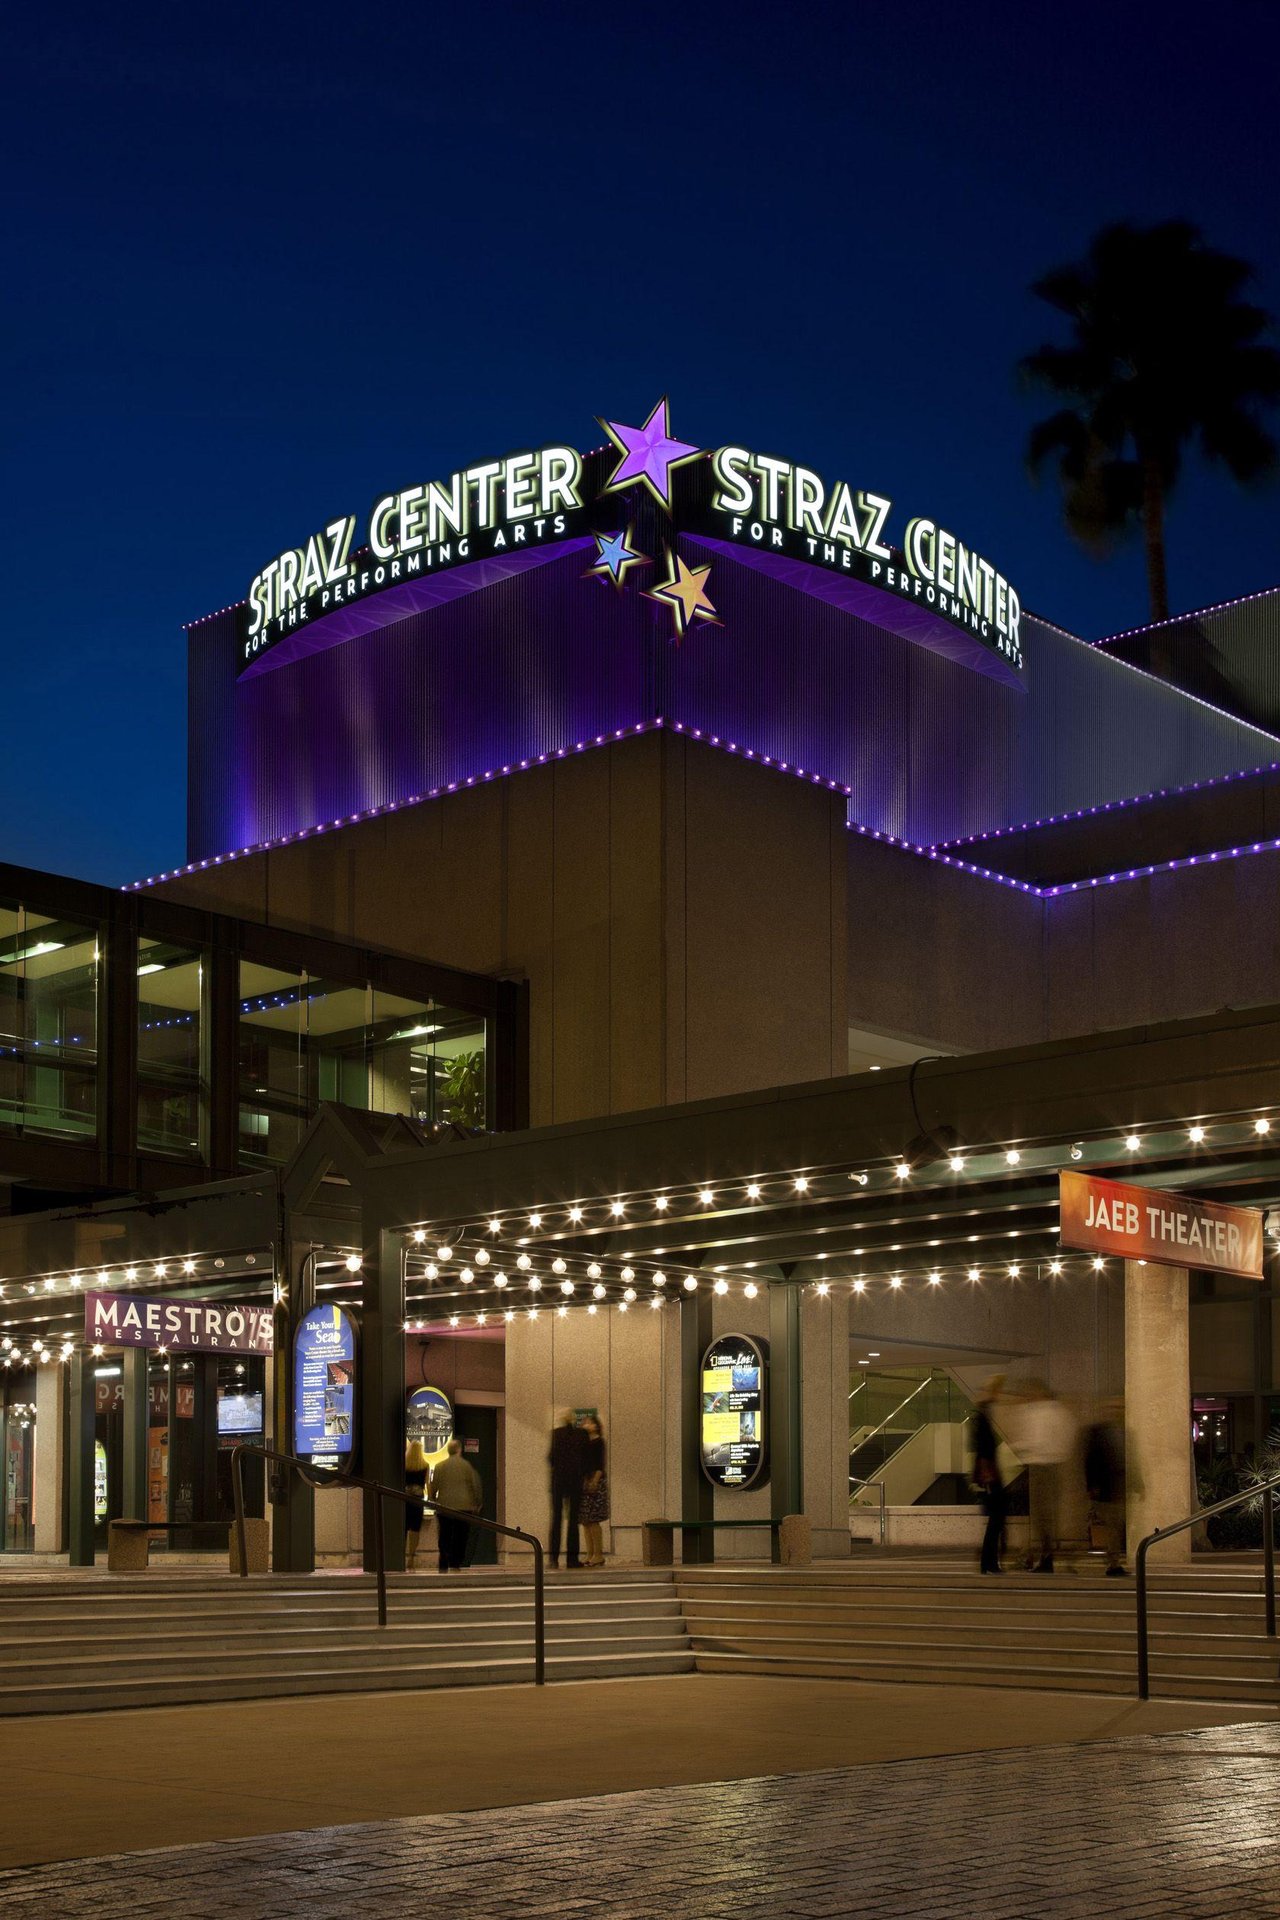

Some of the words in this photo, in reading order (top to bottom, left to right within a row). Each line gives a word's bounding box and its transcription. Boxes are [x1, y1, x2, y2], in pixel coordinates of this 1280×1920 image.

[245, 626, 269, 659] FOR
[277, 602, 309, 631] THE
[321, 538, 470, 607] PERFORMING
[493, 514, 567, 548] ARTS
[248, 514, 355, 635] STRAZ
[370, 446, 584, 559] CENTER
[712, 446, 892, 560] STRAZ
[904, 517, 1021, 649] CENTER
[732, 517, 784, 547] FOR
[806, 537, 852, 568] THE
[871, 560, 988, 637] PERFORMING
[997, 632, 1024, 670] ARTS
[1085, 1195, 1139, 1235] JAEB
[1146, 1206, 1241, 1254] THEATER
[94, 1298, 273, 1339] MAESTRO'S
[95, 1327, 274, 1350] RESTAURANT
[305, 1321, 320, 1330] Take
